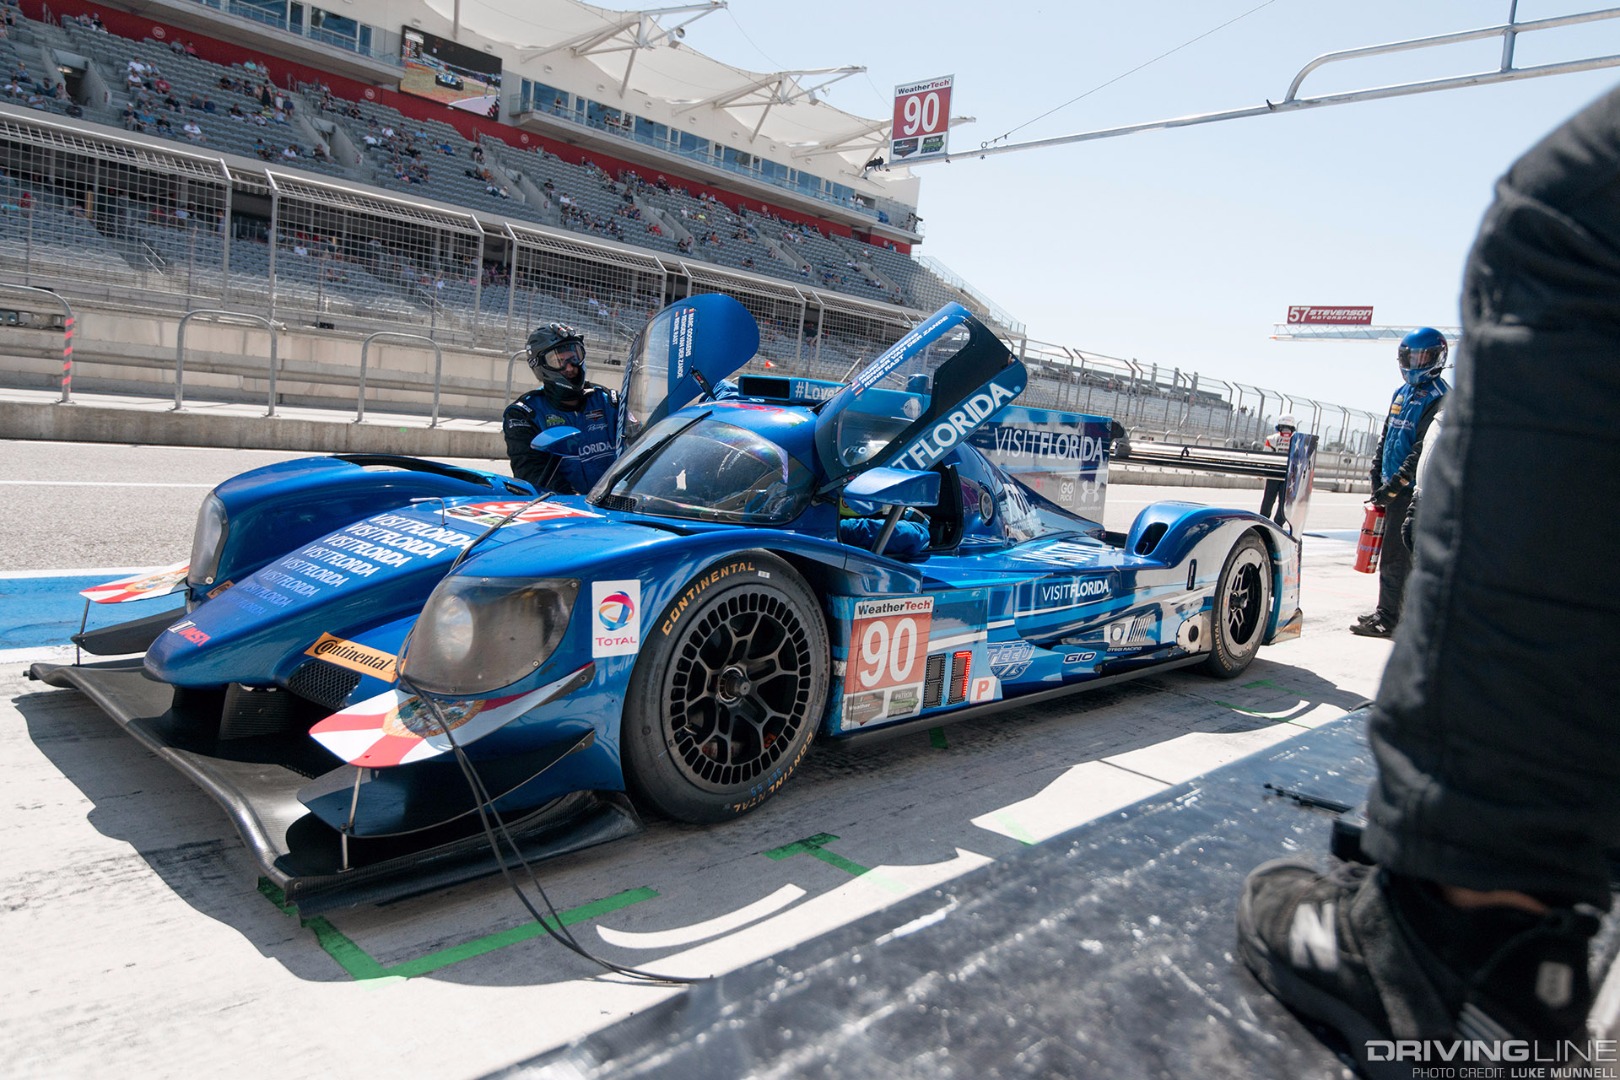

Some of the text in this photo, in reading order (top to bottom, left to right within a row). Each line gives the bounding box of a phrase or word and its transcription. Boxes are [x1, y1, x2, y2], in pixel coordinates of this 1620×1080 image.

[898, 79, 950, 95] WeatherTech
[903, 92, 940, 136] 90
[1289, 306, 1311, 322] 57
[861, 315, 949, 384] RENGER VAN DER ZANDE
[858, 363, 879, 381] MARC
[864, 354, 904, 388] RENE RAST
[888, 382, 1022, 470] TFLORIDA
[578, 441, 614, 456] LORIDA
[994, 427, 1107, 462] VISITFLORIDA
[343, 522, 447, 559] VISITFLORIDA
[368, 513, 477, 550] VISITFLORIDA
[301, 545, 381, 578] VISITFLORIDA
[322, 533, 413, 568] VISITFLORIDA
[259, 569, 320, 598] VISITFLORIDA
[280, 556, 350, 588] VISITFLORIDA
[661, 561, 757, 636] CONTINENTAL
[1042, 579, 1112, 601] VISITFLORIDA
[858, 599, 932, 615] WeatherTech
[314, 639, 395, 672] Continental
[860, 617, 918, 687] 90
[976, 680, 990, 700] P
